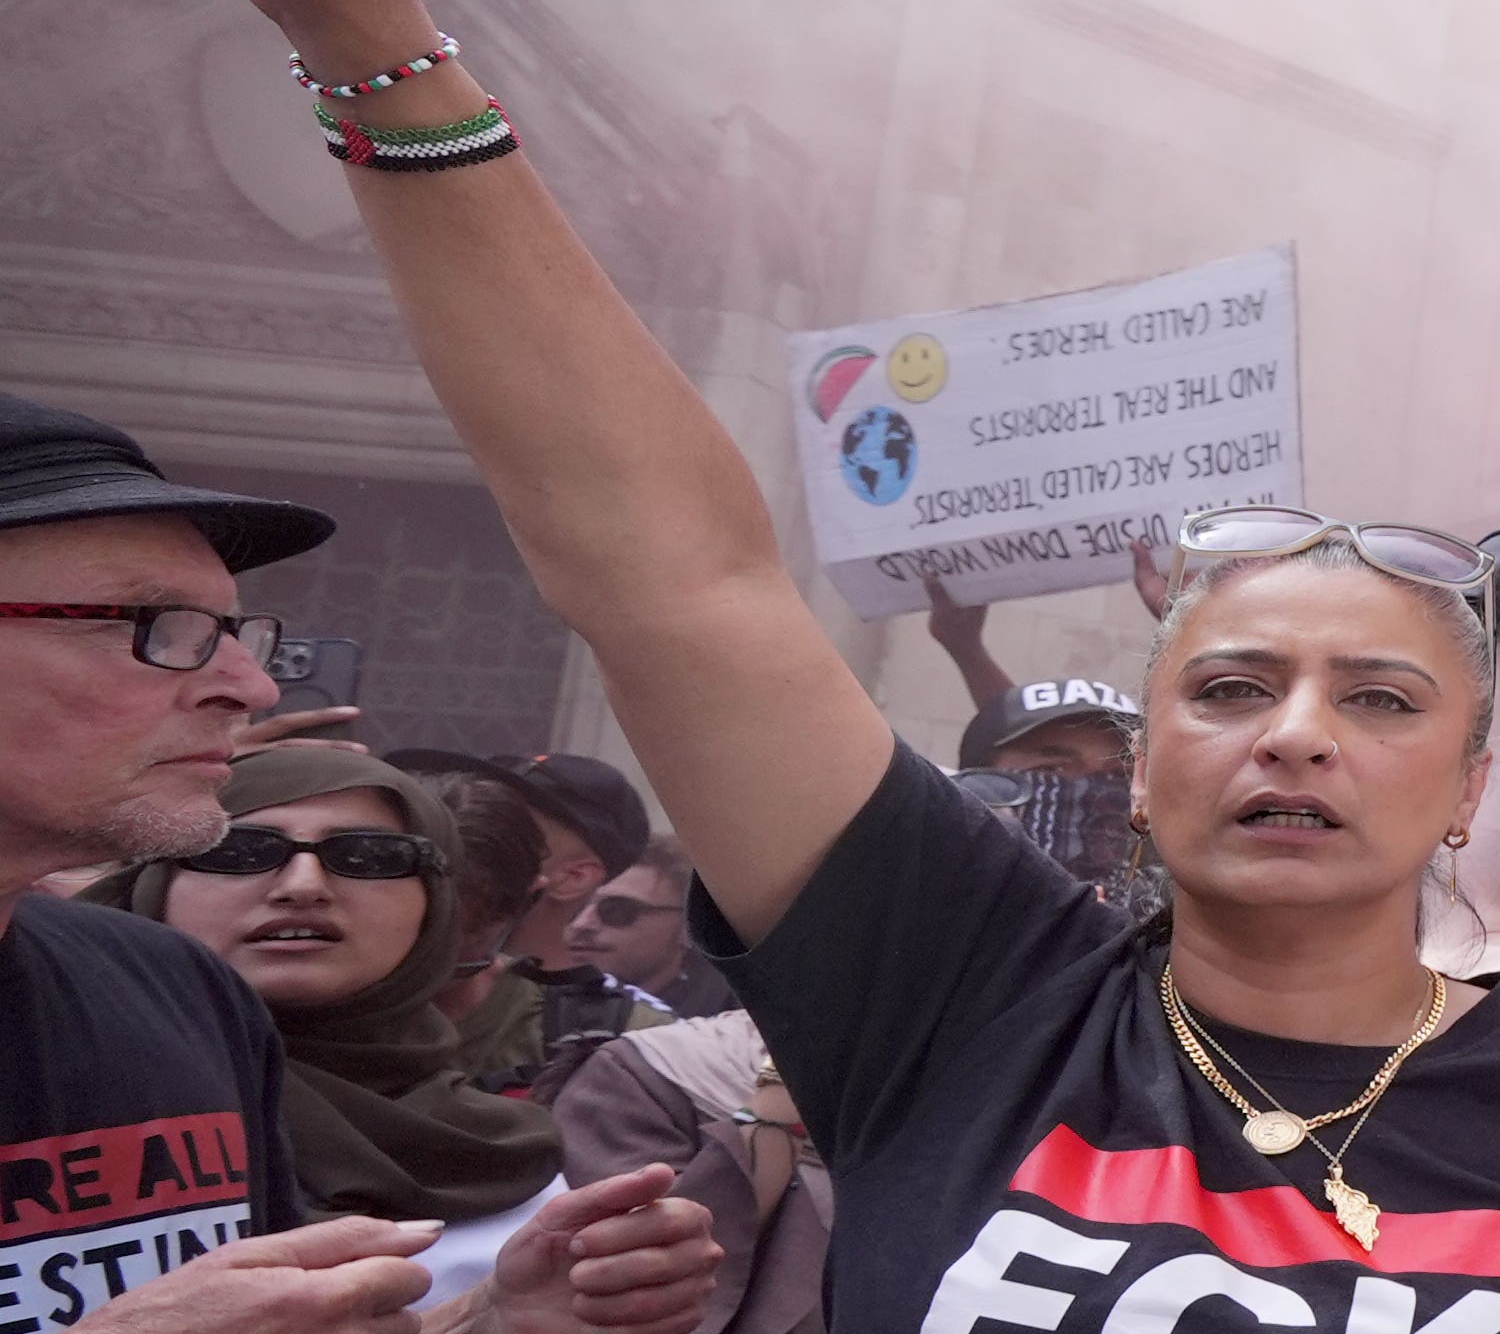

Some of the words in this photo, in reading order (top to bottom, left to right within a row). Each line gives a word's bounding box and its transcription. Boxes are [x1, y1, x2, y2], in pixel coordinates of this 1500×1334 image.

[1123, 301, 1210, 344] CALLED
[1221, 289, 1268, 330] ARE
[1175, 371, 1224, 409] THE
[1227, 360, 1278, 400] AND
[968, 397, 1106, 446] TERRORISTS
[1113, 381, 1168, 423] REAL
[1126, 451, 1174, 487] ARE
[1184, 430, 1281, 478] HEROES
[1041, 457, 1121, 500] CALLED
[874, 541, 985, 583] WORLD
[982, 528, 1071, 569] DOWN
[0, 1144, 113, 1225] RE
